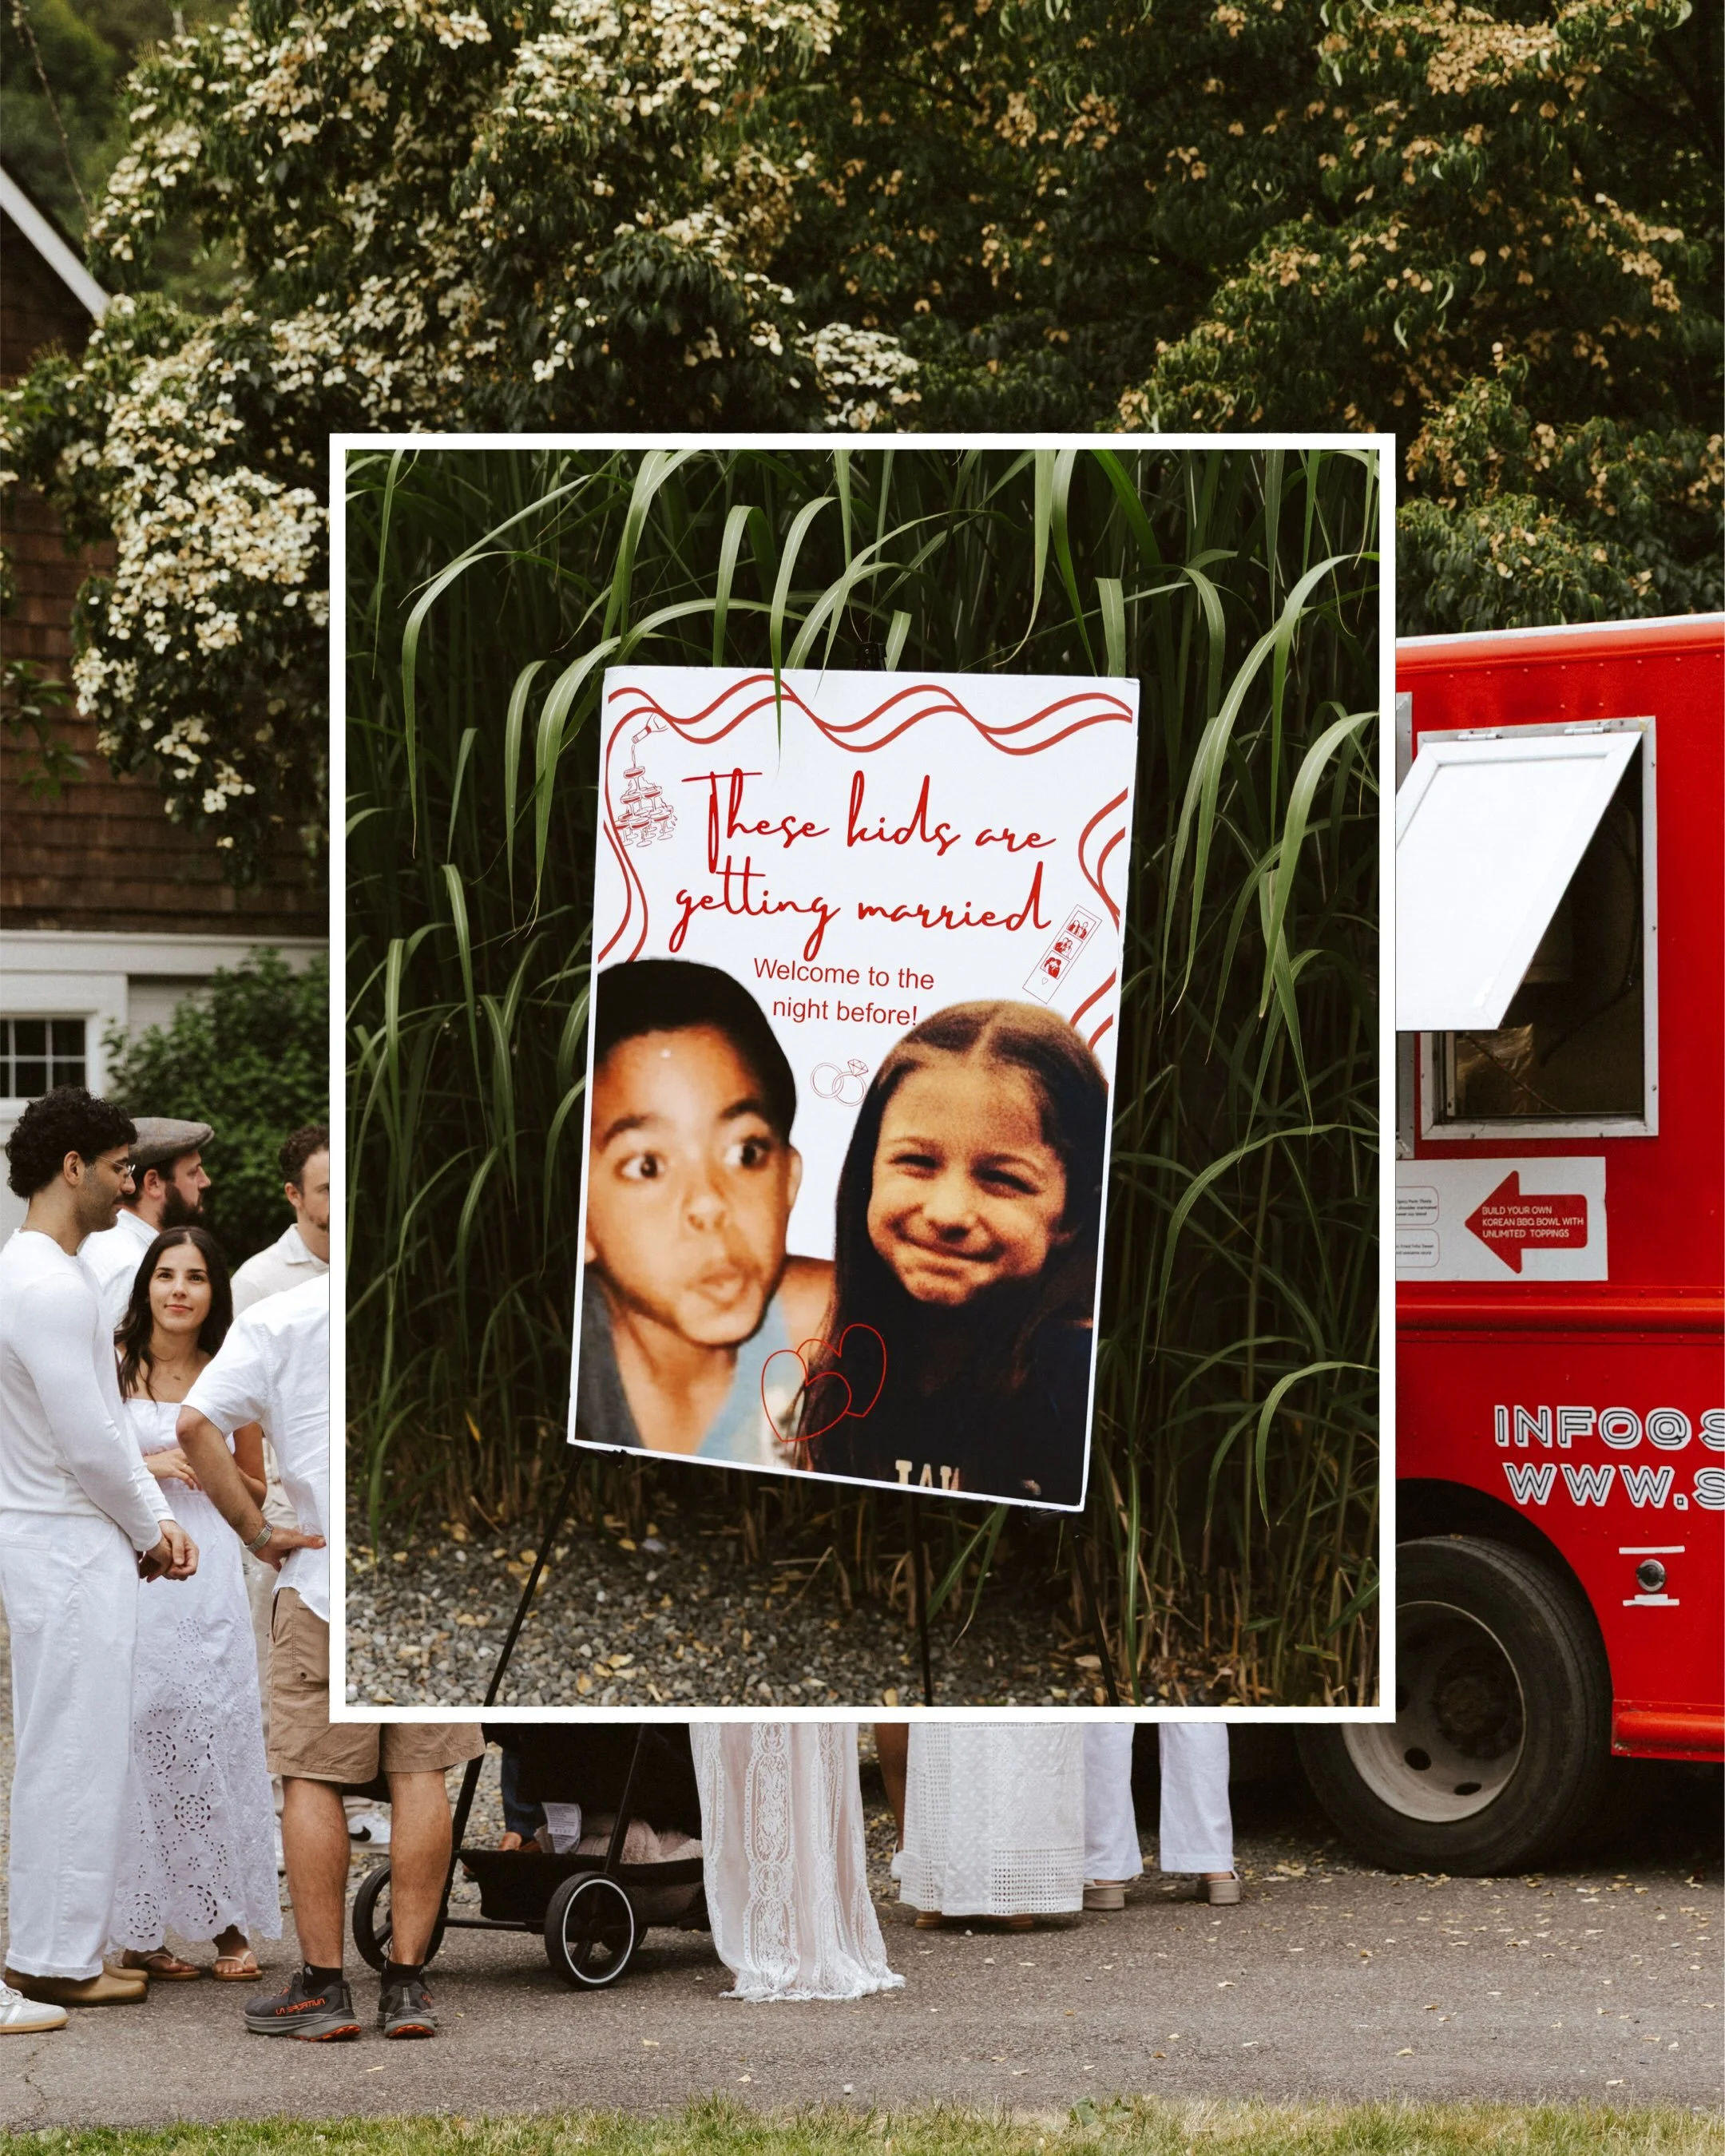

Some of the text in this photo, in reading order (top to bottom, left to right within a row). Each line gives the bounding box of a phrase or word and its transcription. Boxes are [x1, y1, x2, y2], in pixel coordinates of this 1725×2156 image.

[681, 767, 1057, 874] These kids are
[668, 855, 1052, 962] getting married
[754, 958, 934, 990] Welcome to the
[772, 999, 918, 1026] night before!
[1482, 1206, 1552, 1215] BUILD YOUR OWN
[1482, 1217, 1584, 1227] KOREAN BBQ BOWL WITH
[1482, 1229, 1570, 1239] UNLIMITED TOPPINGS
[1494, 1405, 1725, 1452] INFO@S
[1502, 1462, 1725, 1511] WWW.S
[276, 1997, 326, 2016] LA SPORTIVA
